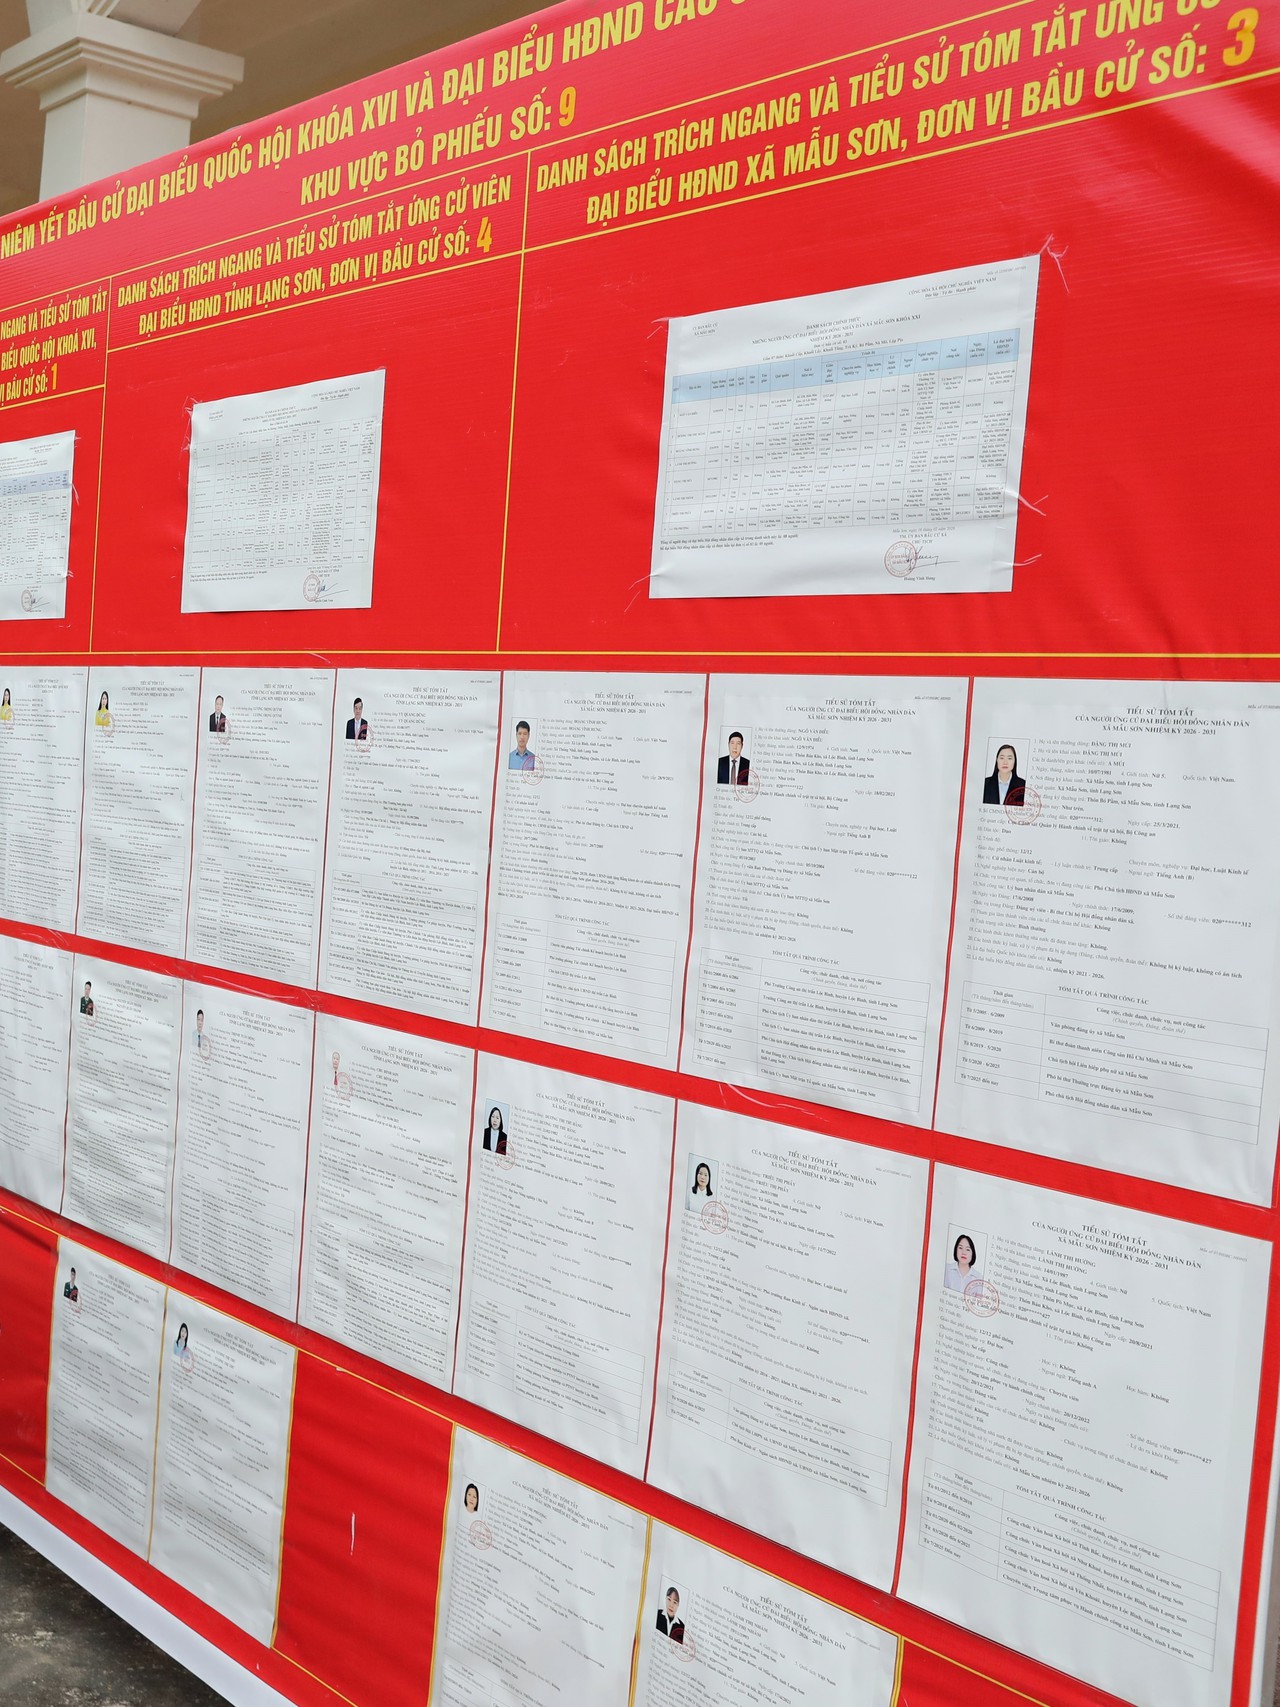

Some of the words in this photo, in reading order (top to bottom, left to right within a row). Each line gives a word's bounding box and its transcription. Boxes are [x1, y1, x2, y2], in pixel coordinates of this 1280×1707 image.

[0, 224, 35, 258] NIÊM
[40, 207, 64, 244] YẾT
[67, 196, 97, 235] BẦU
[101, 181, 125, 222] CỬ
[126, 180, 154, 215] ĐẠI
[159, 156, 198, 202] BIỂU
[203, 138, 252, 188] QUỐC
[258, 126, 292, 168] HỘI
[297, 105, 354, 154] KHÓA
[361, 90, 398, 132] XVI
[406, 71, 434, 116] VÀ
[442, 59, 484, 105] ĐẠI
[492, 24, 553, 87] BIỂU
[562, 2, 644, 63] HĐND
[299, 166, 341, 205] KHU
[348, 151, 388, 192] VỰC
[395, 127, 424, 176] BỎ
[432, 106, 502, 164] PHIẾU
[510, 87, 551, 140] SỐ:
[558, 87, 577, 126] 9
[535, 153, 588, 192] DANH
[594, 136, 647, 176] SÁCH
[653, 117, 714, 160] TRÍCH
[721, 93, 801, 142] NGANG
[810, 76, 839, 118] VÀ
[849, 54, 904, 107] TIỂU
[912, 36, 954, 89] SỬ
[959, 28, 1021, 77] TÓM
[1031, 4, 1087, 56] TẮT
[586, 190, 619, 226] ĐẠI
[625, 168, 672, 214] BIỂU
[679, 160, 738, 202] HĐND
[745, 144, 775, 185] XÃ
[784, 126, 839, 176] MẪU
[847, 117, 907, 160] SƠN,
[917, 97, 976, 143] ĐƠN
[985, 88, 1012, 129] VỊ
[1021, 62, 1084, 117] BẦU
[1095, 39, 1144, 98] CỬ
[1148, 24, 1207, 84] SỐ:
[1222, 8, 1260, 66] 3
[117, 281, 147, 307] DANH
[150, 272, 180, 298] SÁCH
[183, 260, 216, 288] TRÍCH
[219, 247, 262, 279] NGANG
[266, 241, 281, 265] VÀ
[286, 224, 315, 260] TIỂU
[319, 215, 339, 250] SỬ
[342, 214, 373, 244] TÓM
[378, 201, 404, 234] TẮT
[408, 195, 440, 226] ỨNG
[445, 177, 469, 216] CỬ
[472, 174, 512, 209] VIÊN
[138, 312, 157, 336] ĐẠI
[160, 298, 186, 329] BIỂU
[189, 295, 221, 322] HĐND
[225, 282, 252, 312] TỈNH
[256, 276, 290, 308] LẠNG
[294, 267, 325, 295] SƠN,
[330, 257, 360, 286] ĐƠN
[364, 253, 378, 281] VỊ
[382, 238, 413, 274] BẦU
[418, 227, 440, 265] CỬ
[443, 221, 471, 258] SỐ:
[476, 217, 493, 252] 4
[0, 315, 26, 339] NGANG
[28, 312, 38, 332] VÀ
[40, 304, 57, 328] TIỂU
[58, 301, 71, 323] SỬ
[72, 297, 90, 318] TÓM
[92, 287, 108, 313] TẮT
[1, 347, 18, 371] BIỂU
[20, 343, 40, 367] QUỐC
[42, 336, 55, 362] HỘI
[57, 333, 78, 356] KHOÁ
[81, 328, 97, 350] XVI,
[6, 377, 21, 400] BẦU
[23, 374, 34, 396] CỬ
[35, 367, 49, 393] SỐ:
[51, 363, 58, 389] 1
